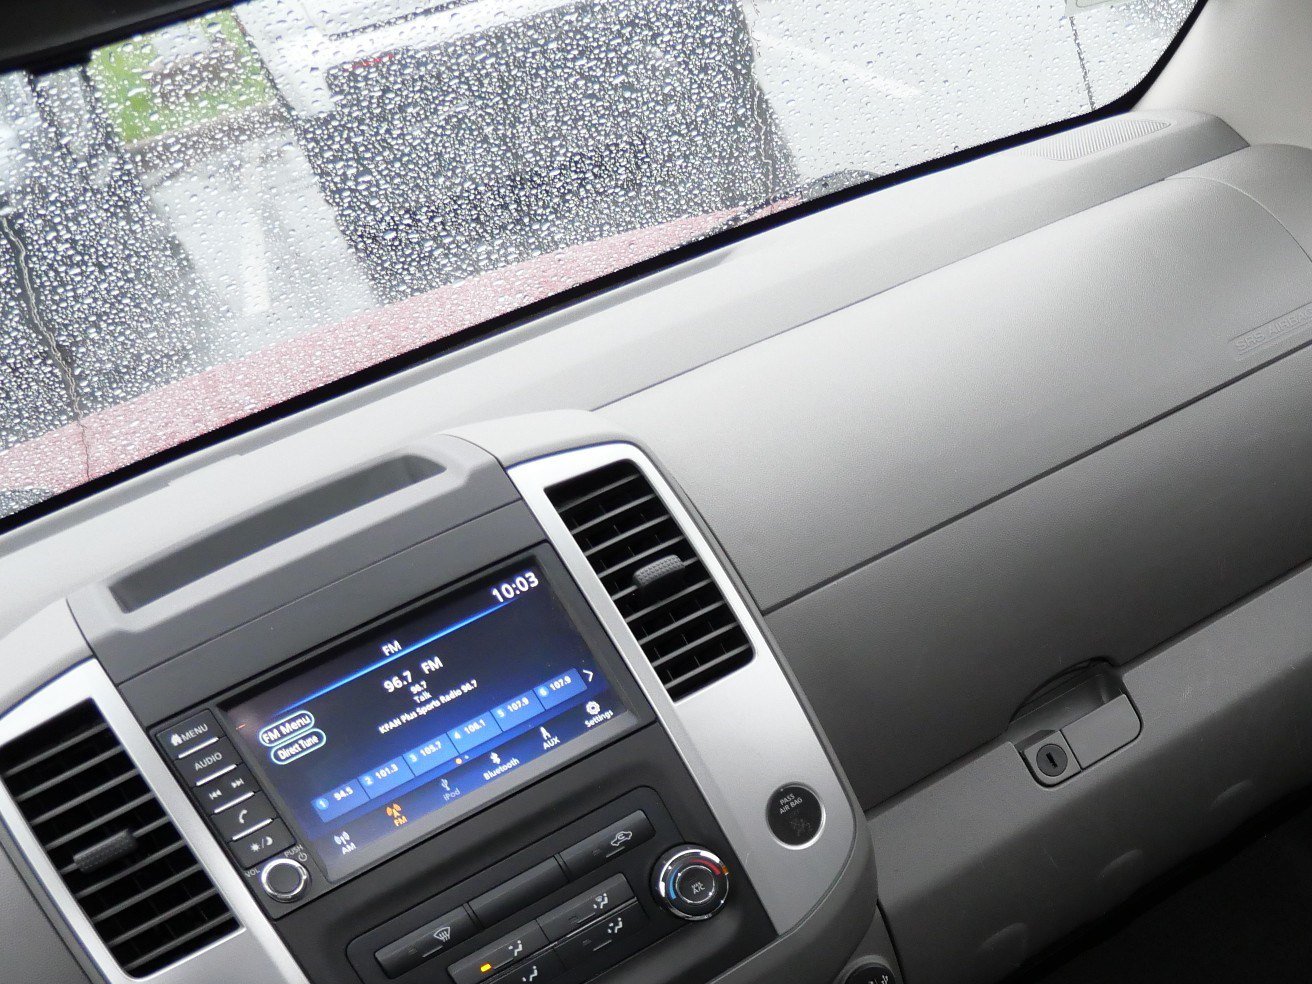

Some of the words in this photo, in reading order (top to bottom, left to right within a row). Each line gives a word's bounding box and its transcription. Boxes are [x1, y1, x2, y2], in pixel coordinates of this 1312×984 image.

[491, 572, 539, 603] 10:03
[382, 640, 402, 656] FM
[384, 671, 412, 692] 96.7
[421, 656, 443, 674] FM
[550, 675, 572, 691] 107.9
[413, 691, 432, 703] Talk
[379, 718, 401, 734] KFAN
[416, 700, 441, 715] Sports
[440, 689, 462, 704] Radio
[584, 709, 614, 728] Settings
[181, 724, 209, 742] MENU
[262, 728, 281, 744] FM
[280, 714, 311, 735] Menu
[277, 742, 302, 761] Direct
[300, 734, 319, 750] Tune
[543, 736, 561, 750] AUX
[194, 752, 223, 771] AUDIO
[483, 757, 521, 781] Bluetooth
[443, 787, 461, 802] iPod
[780, 793, 796, 806] PASS
[393, 816, 408, 827] FM
[284, 844, 304, 858] PUSH
[342, 841, 357, 855] AM
[245, 868, 261, 878] VOL
